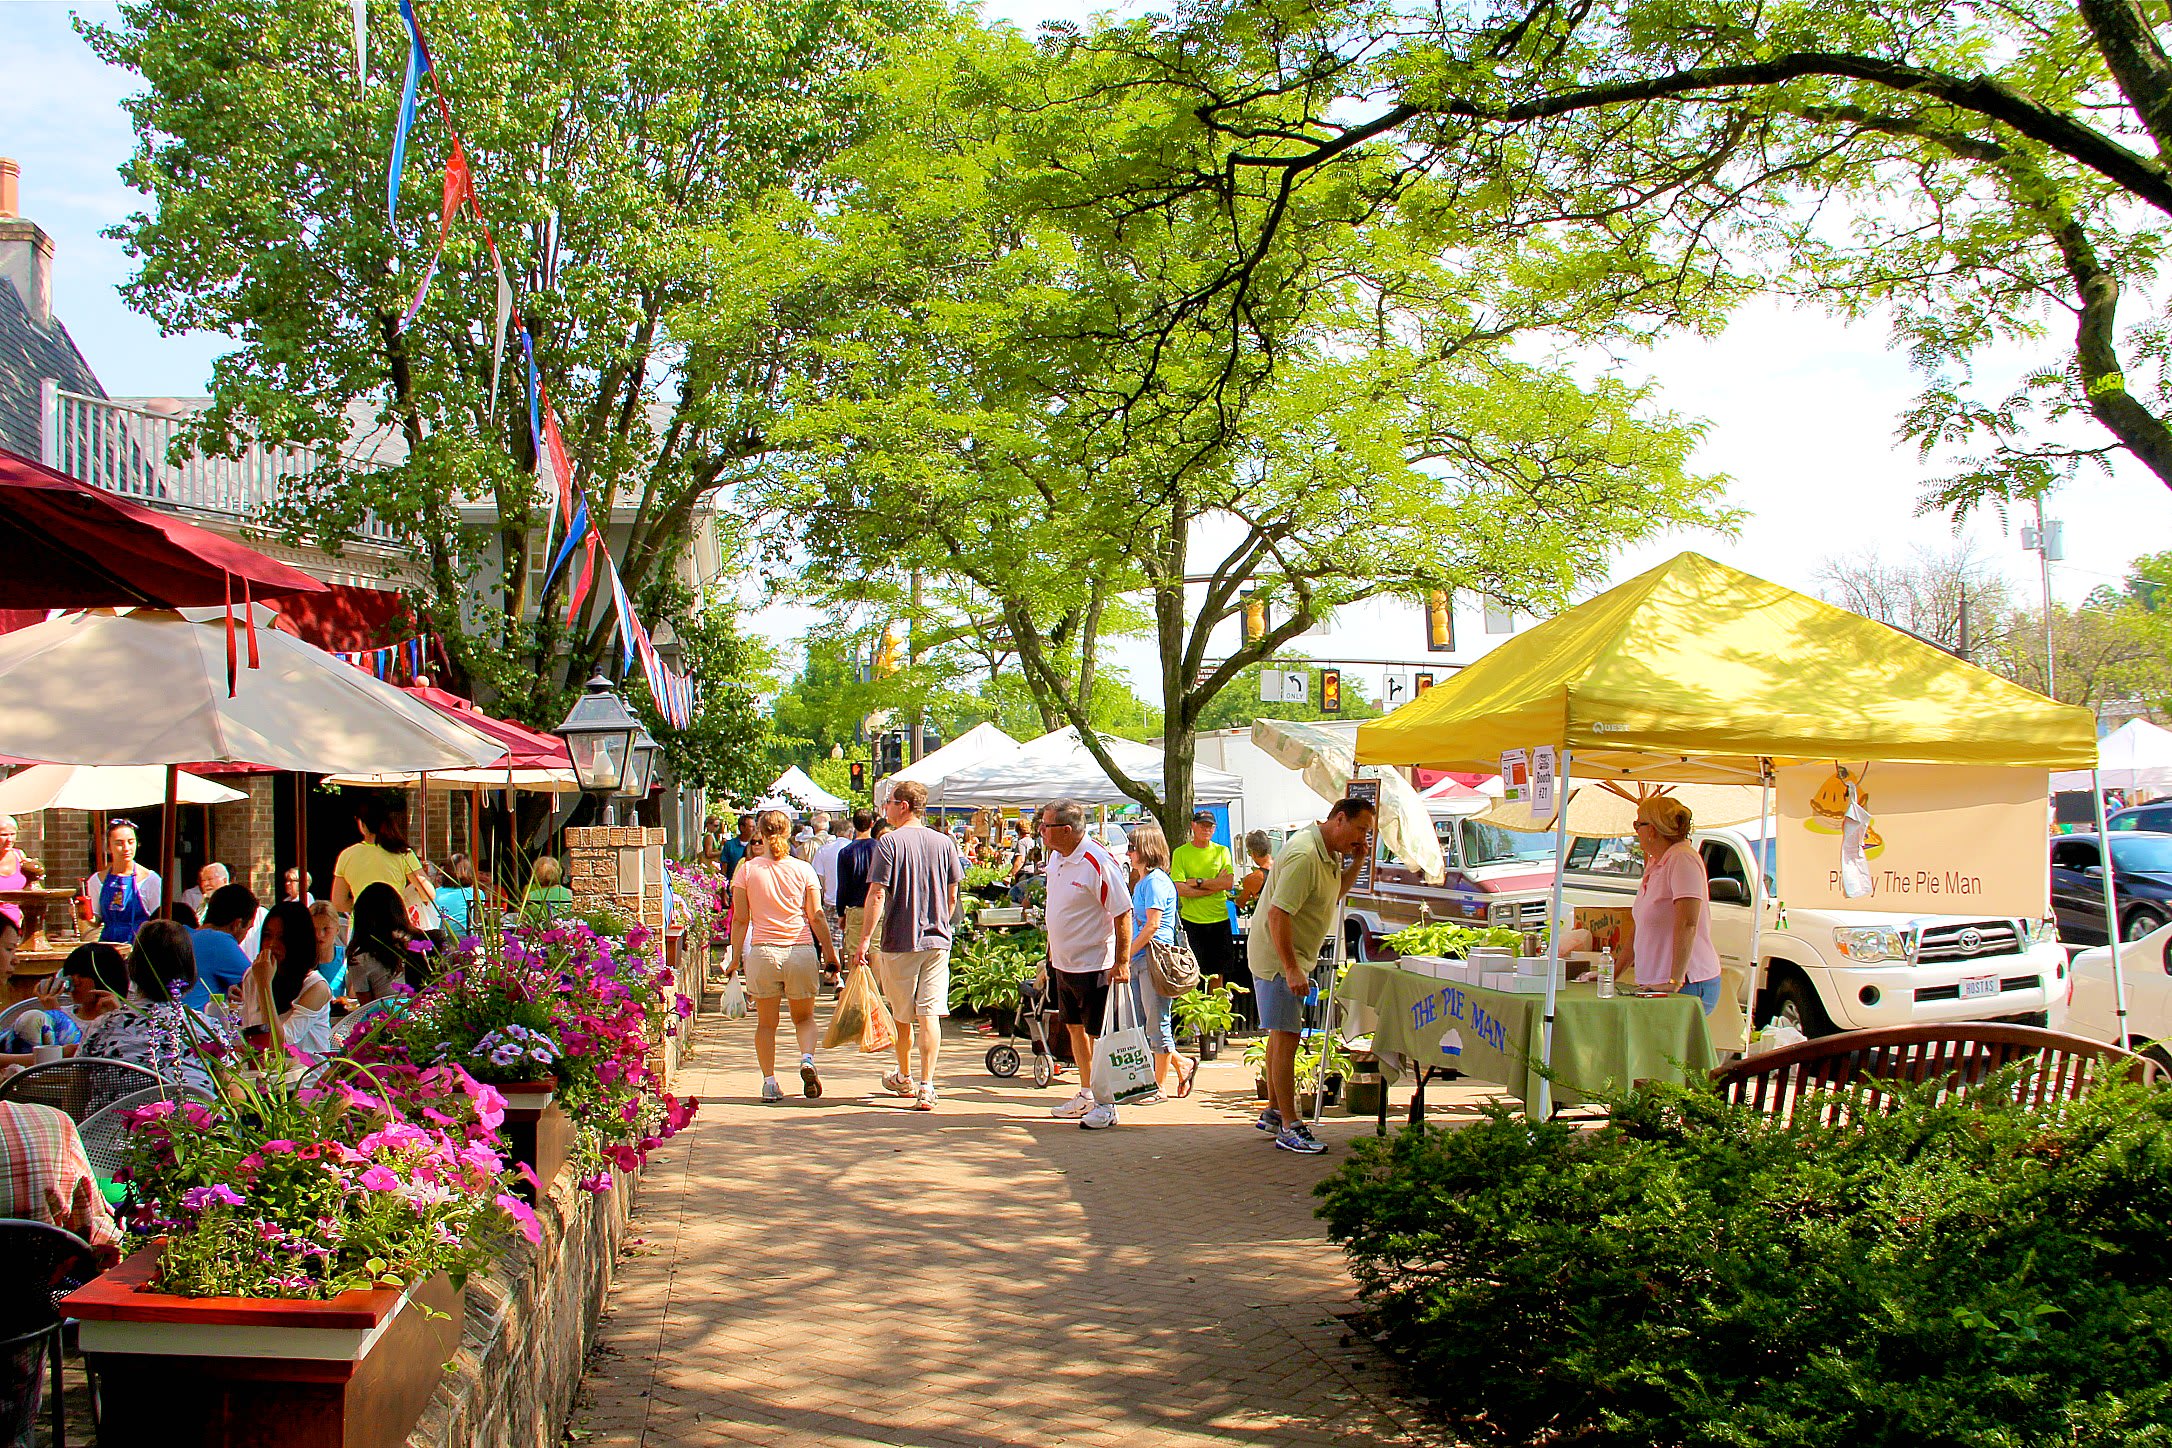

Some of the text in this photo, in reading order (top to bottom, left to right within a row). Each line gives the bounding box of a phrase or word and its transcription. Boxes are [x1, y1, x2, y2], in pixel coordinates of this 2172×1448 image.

[1536, 770, 1551, 784] Booth
[1538, 786, 1548, 799] #21
[1829, 870, 1982, 898] Piy The Pie Man
[1590, 913, 1609, 932] Fresh
[1965, 979, 1994, 995] HOSTAS
[1411, 987, 1507, 1054] THE PIE MAN
[1109, 1048, 1148, 1067] bag,
